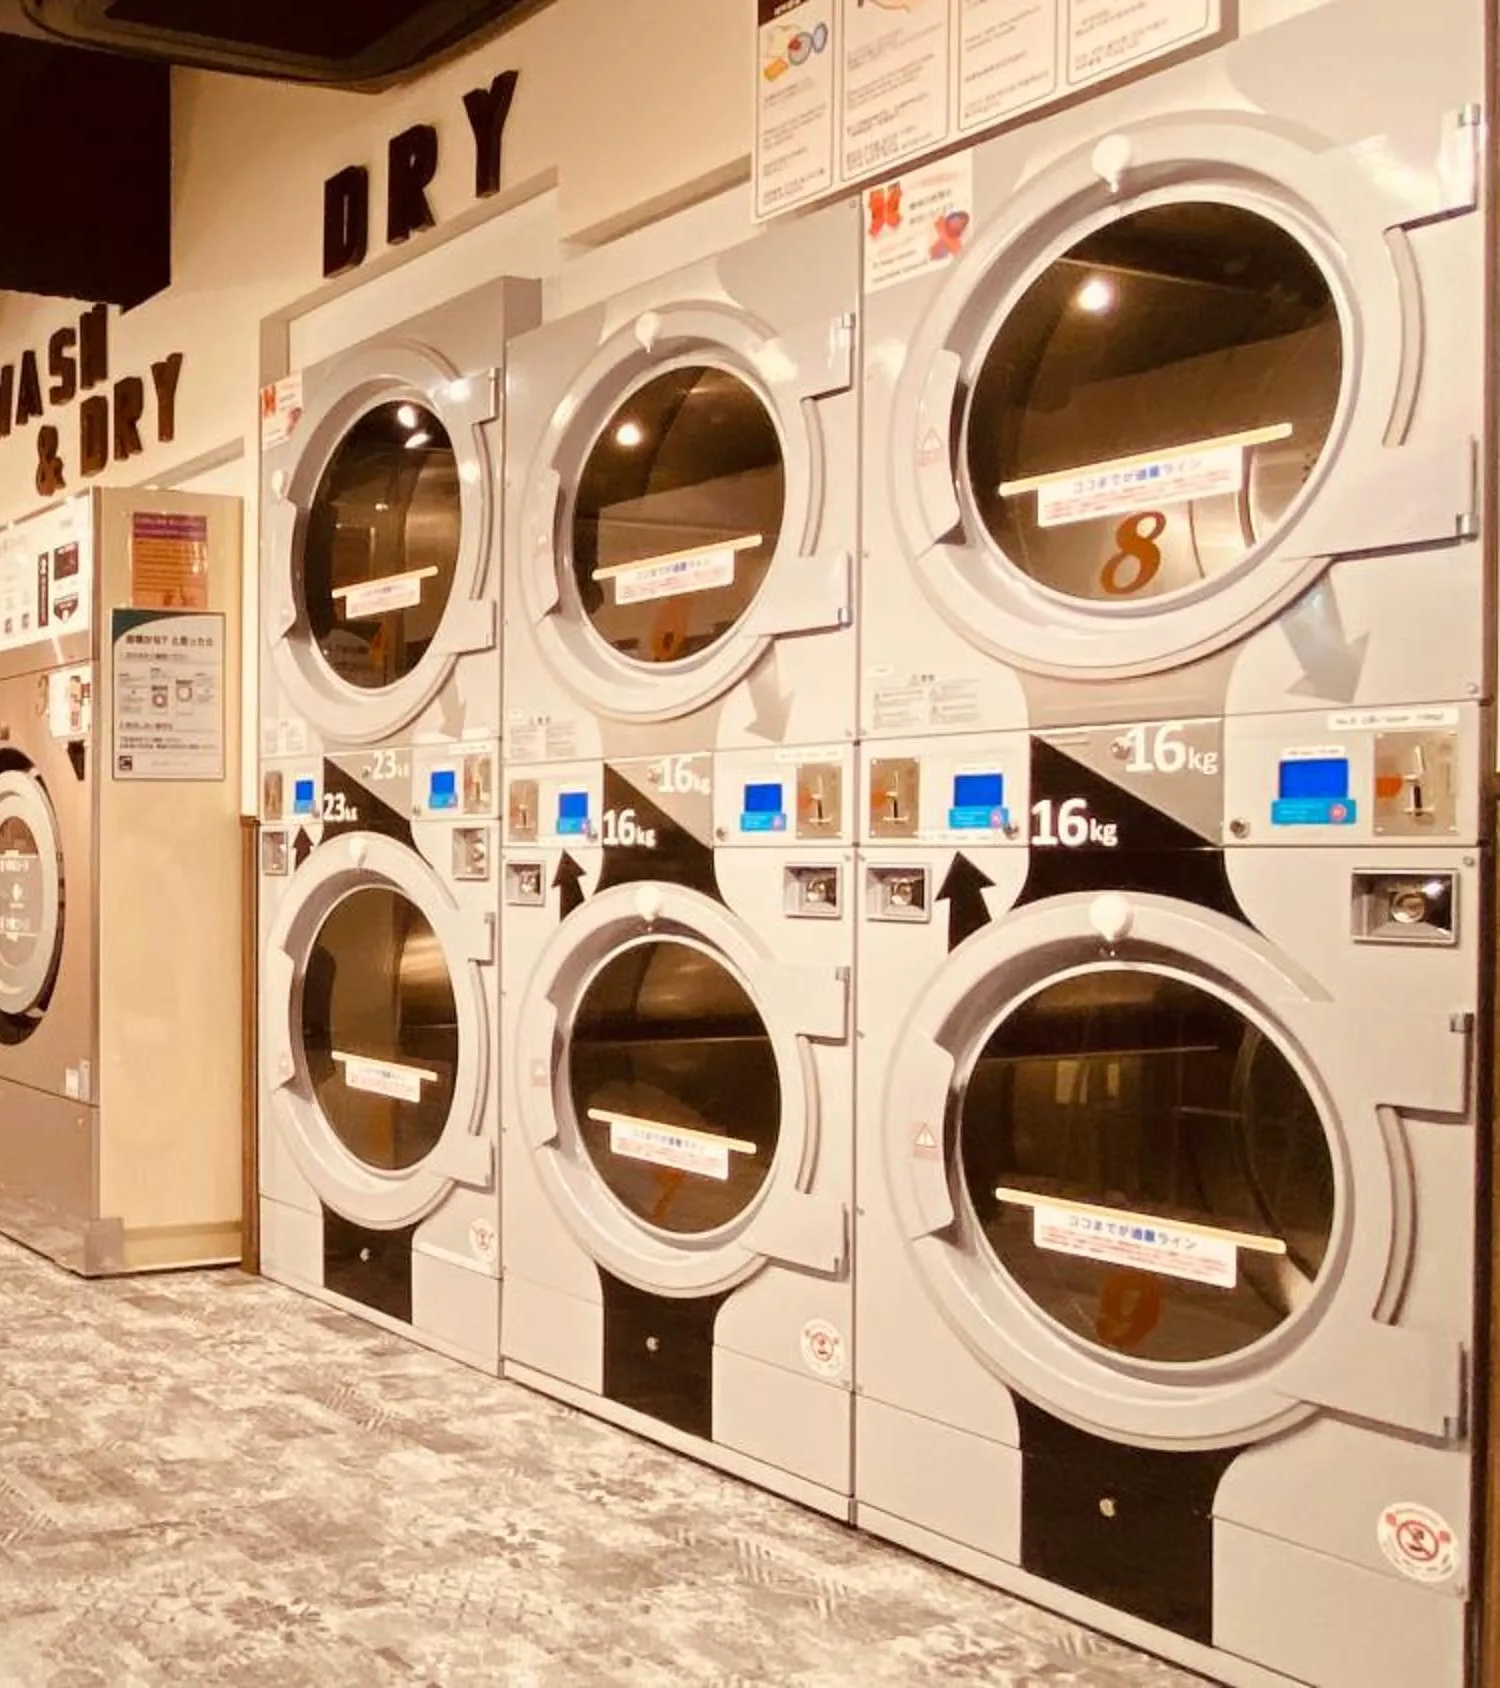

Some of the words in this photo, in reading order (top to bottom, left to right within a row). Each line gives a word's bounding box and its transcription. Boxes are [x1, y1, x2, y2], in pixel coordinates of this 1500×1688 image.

[324, 70, 518, 278] DRY
[36, 425, 66, 496] &
[80, 352, 183, 477] DRY
[1100, 511, 1167, 595] 8
[1125, 722, 1219, 775] 16kg
[603, 808, 656, 849] 16kg
[1031, 798, 1119, 847] 16kg
[653, 1170, 687, 1223] 7
[1096, 1270, 1161, 1348] 9
